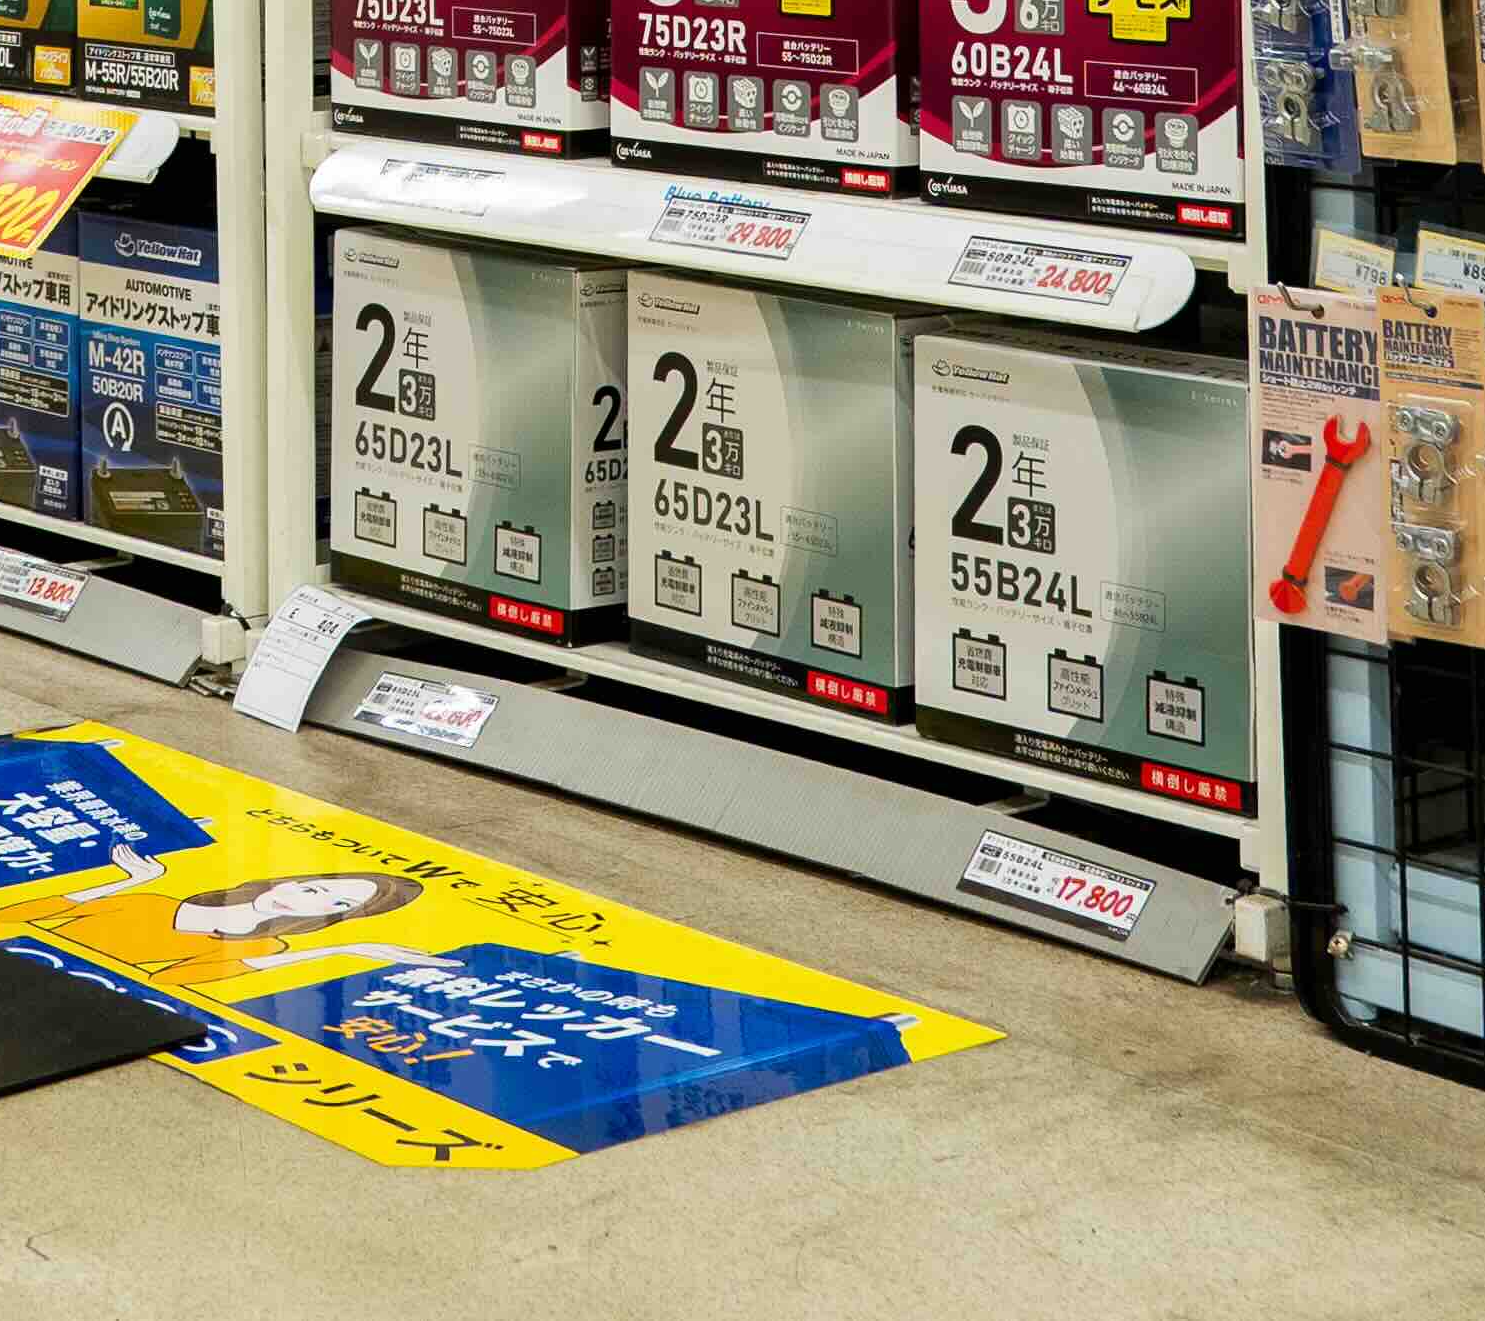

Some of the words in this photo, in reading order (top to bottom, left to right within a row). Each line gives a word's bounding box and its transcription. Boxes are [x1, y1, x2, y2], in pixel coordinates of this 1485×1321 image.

[639, 12, 748, 54] 75D23R
[84, 61, 180, 92] M-55R/55B20R
[950, 40, 1075, 85] 60B24L
[88, 347, 147, 377] M-42R
[91, 376, 145, 402] 50B20R
[352, 421, 465, 480] 65D23L
[654, 479, 775, 541] 65D23L
[950, 551, 1095, 620] 55B24L
[1148, 766, 1232, 809] 横倒し厳禁
[350, 988, 585, 1073] サービスで
[381, 965, 724, 1061] 無料レッカー
[245, 1060, 506, 1163] シリーズ
